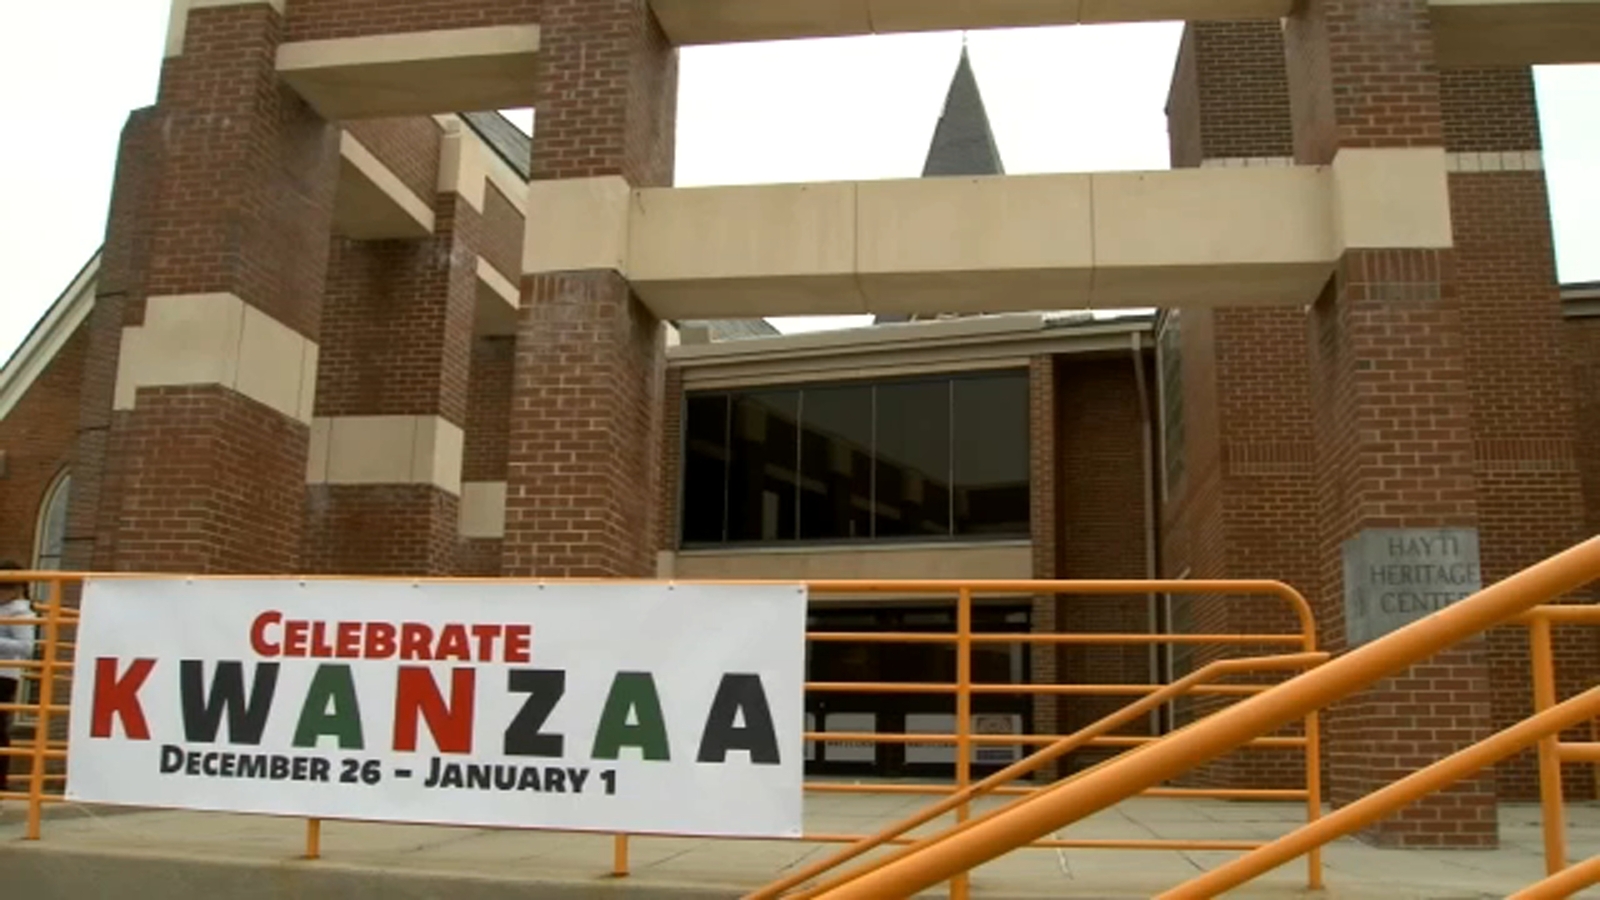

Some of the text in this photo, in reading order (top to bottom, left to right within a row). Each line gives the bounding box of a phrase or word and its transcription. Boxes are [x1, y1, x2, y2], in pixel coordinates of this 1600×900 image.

[1388, 535, 1459, 557] HAYTI
[1370, 562, 1479, 586] HERITAGE
[250, 610, 531, 663] CELEBRATE
[90, 656, 781, 766] KWANZAA
[160, 744, 331, 782] DECEMBER
[339, 758, 381, 786] 26
[423, 756, 590, 794] JANUARY
[599, 769, 616, 795] 1
